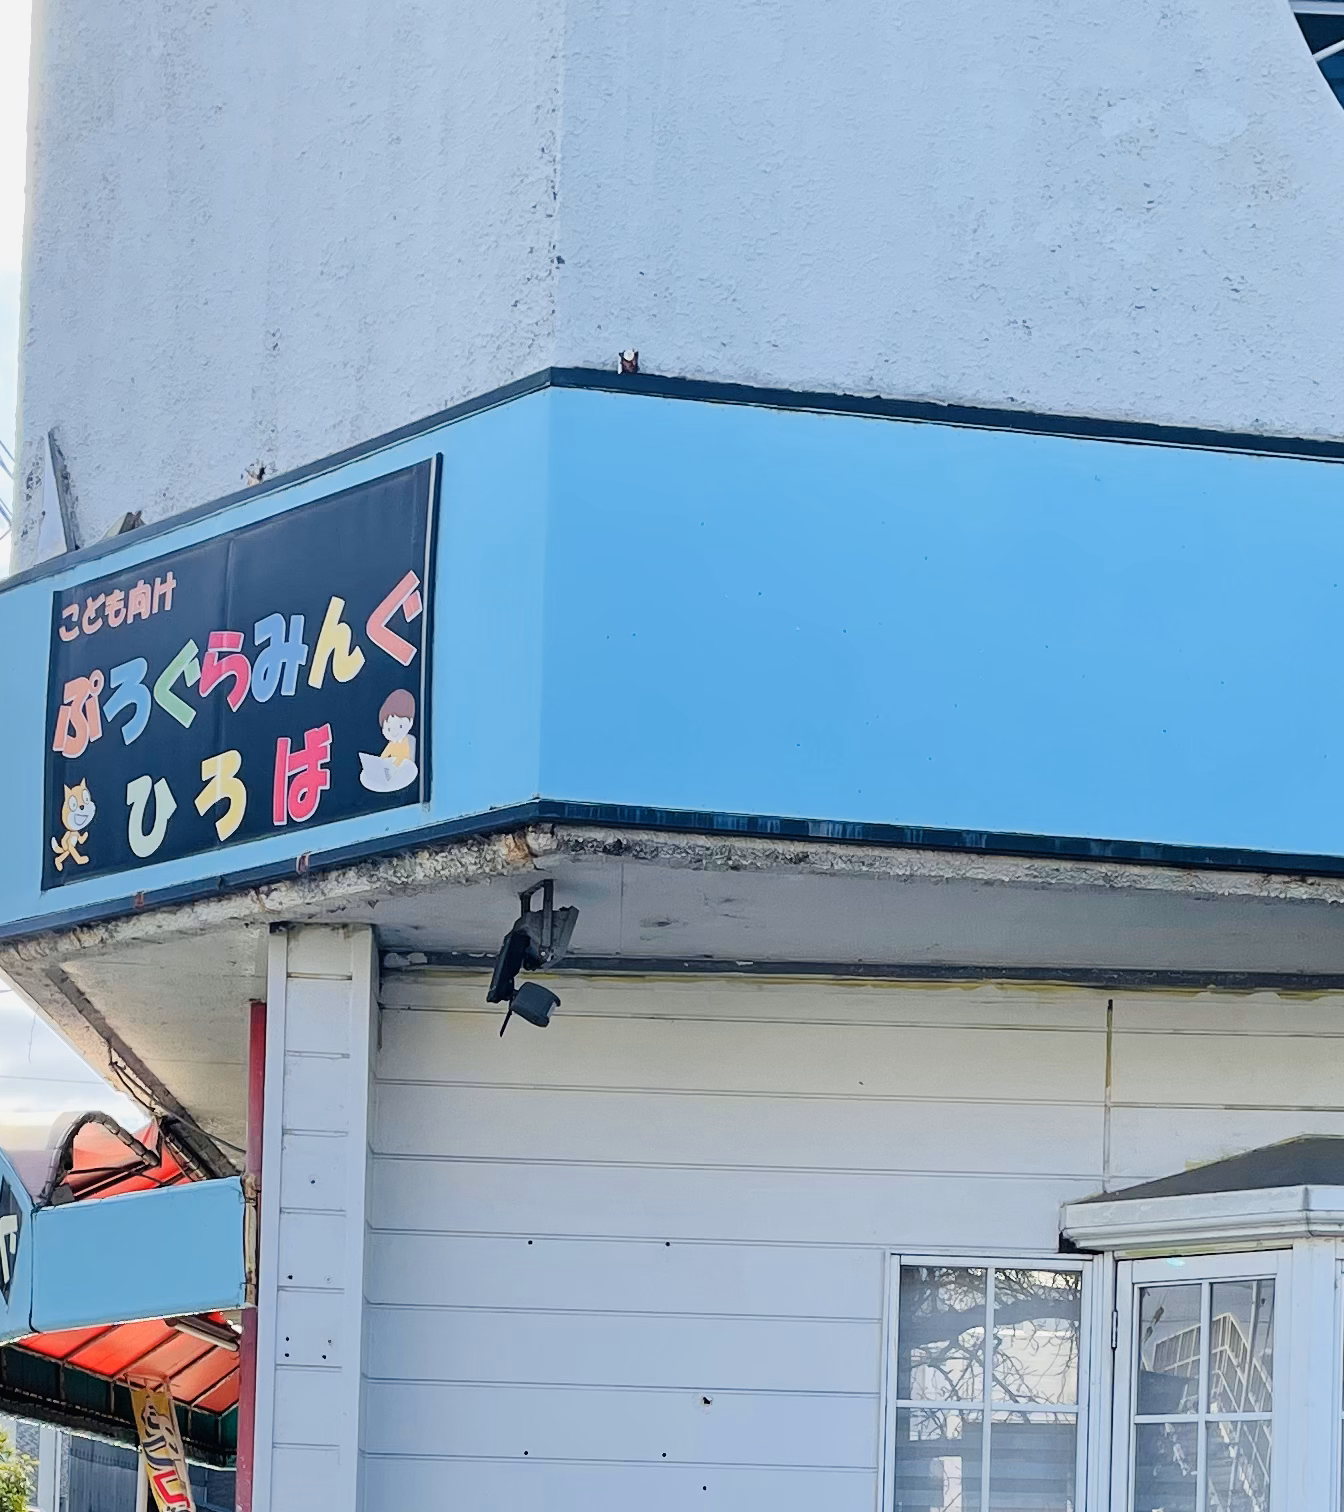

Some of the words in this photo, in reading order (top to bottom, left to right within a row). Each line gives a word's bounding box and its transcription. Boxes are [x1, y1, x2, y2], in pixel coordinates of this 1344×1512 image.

[52, 570, 425, 759] ぷろぐらみんぐ
[58, 571, 176, 642] こども向け
[126, 723, 333, 858] ひろば
